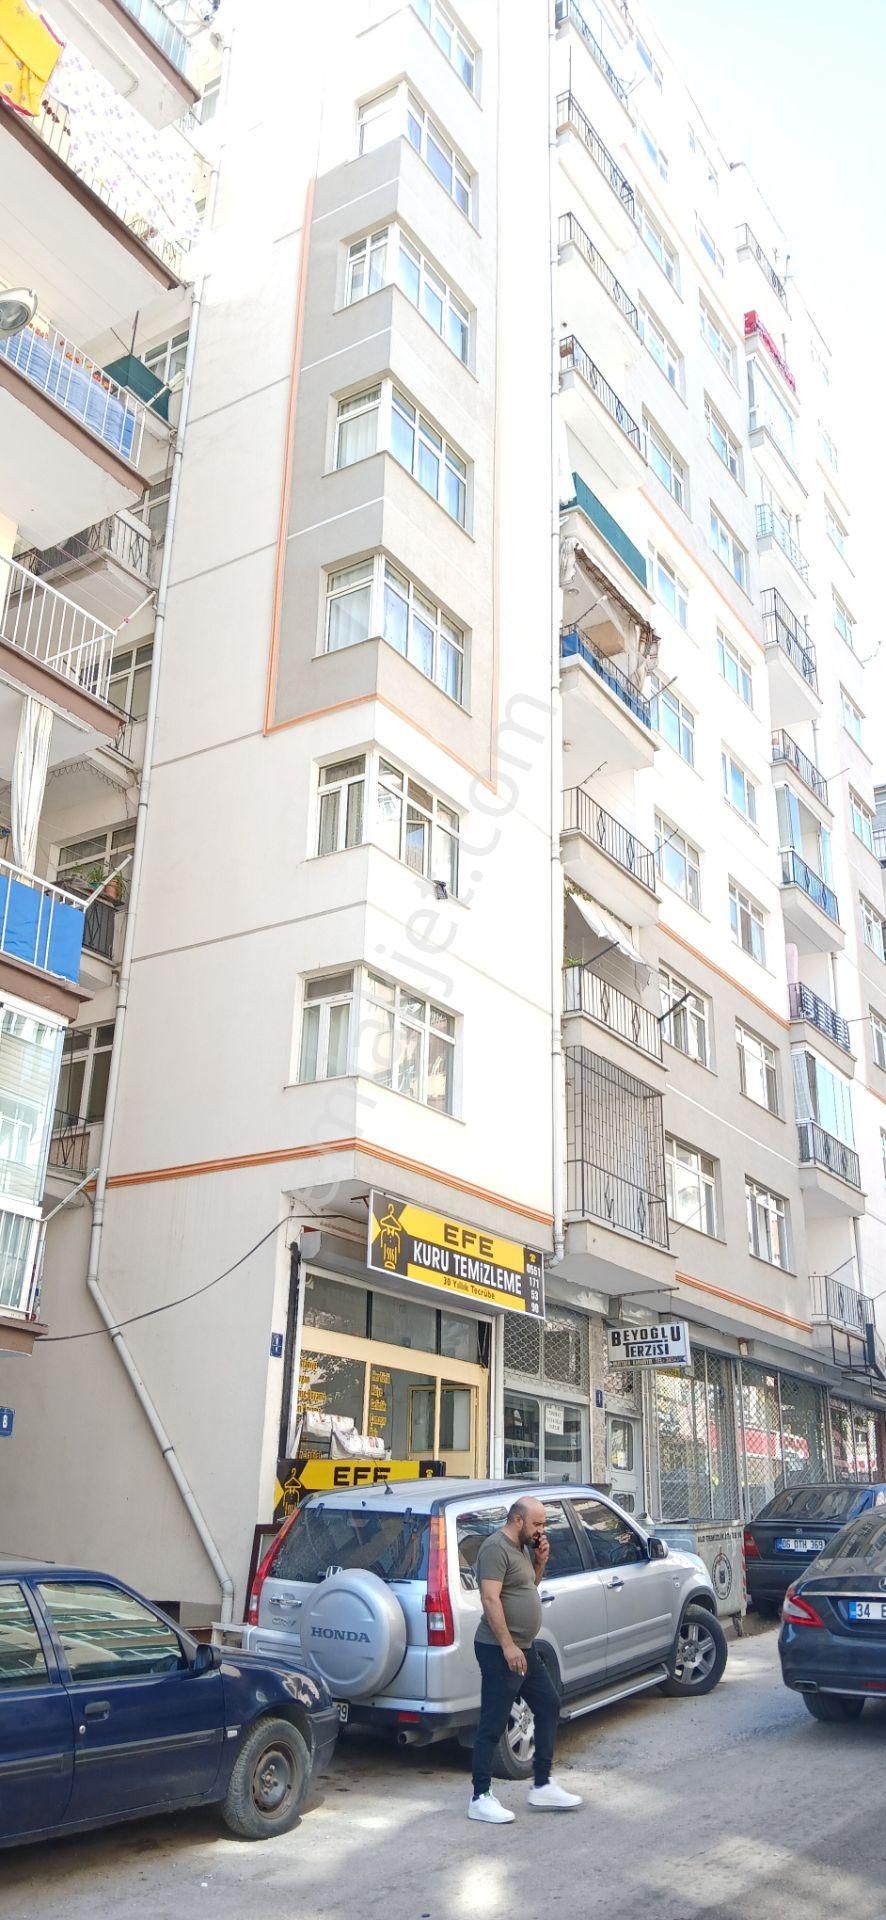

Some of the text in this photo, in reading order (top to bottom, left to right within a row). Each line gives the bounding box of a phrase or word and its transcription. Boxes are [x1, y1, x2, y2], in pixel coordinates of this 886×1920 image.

[443, 1223, 494, 1258] EFE
[413, 1241, 450, 1272] KURU
[526, 1263, 541, 1277] 0551
[443, 1276, 451, 1286] 30
[470, 1285, 495, 1299] Tecrübe
[529, 1276, 539, 1289] 171
[530, 1289, 539, 1301] 53
[2, 1414, 8, 1429] 8
[857, 1603, 870, 1618] 34
[311, 1626, 371, 1643] HONDA
